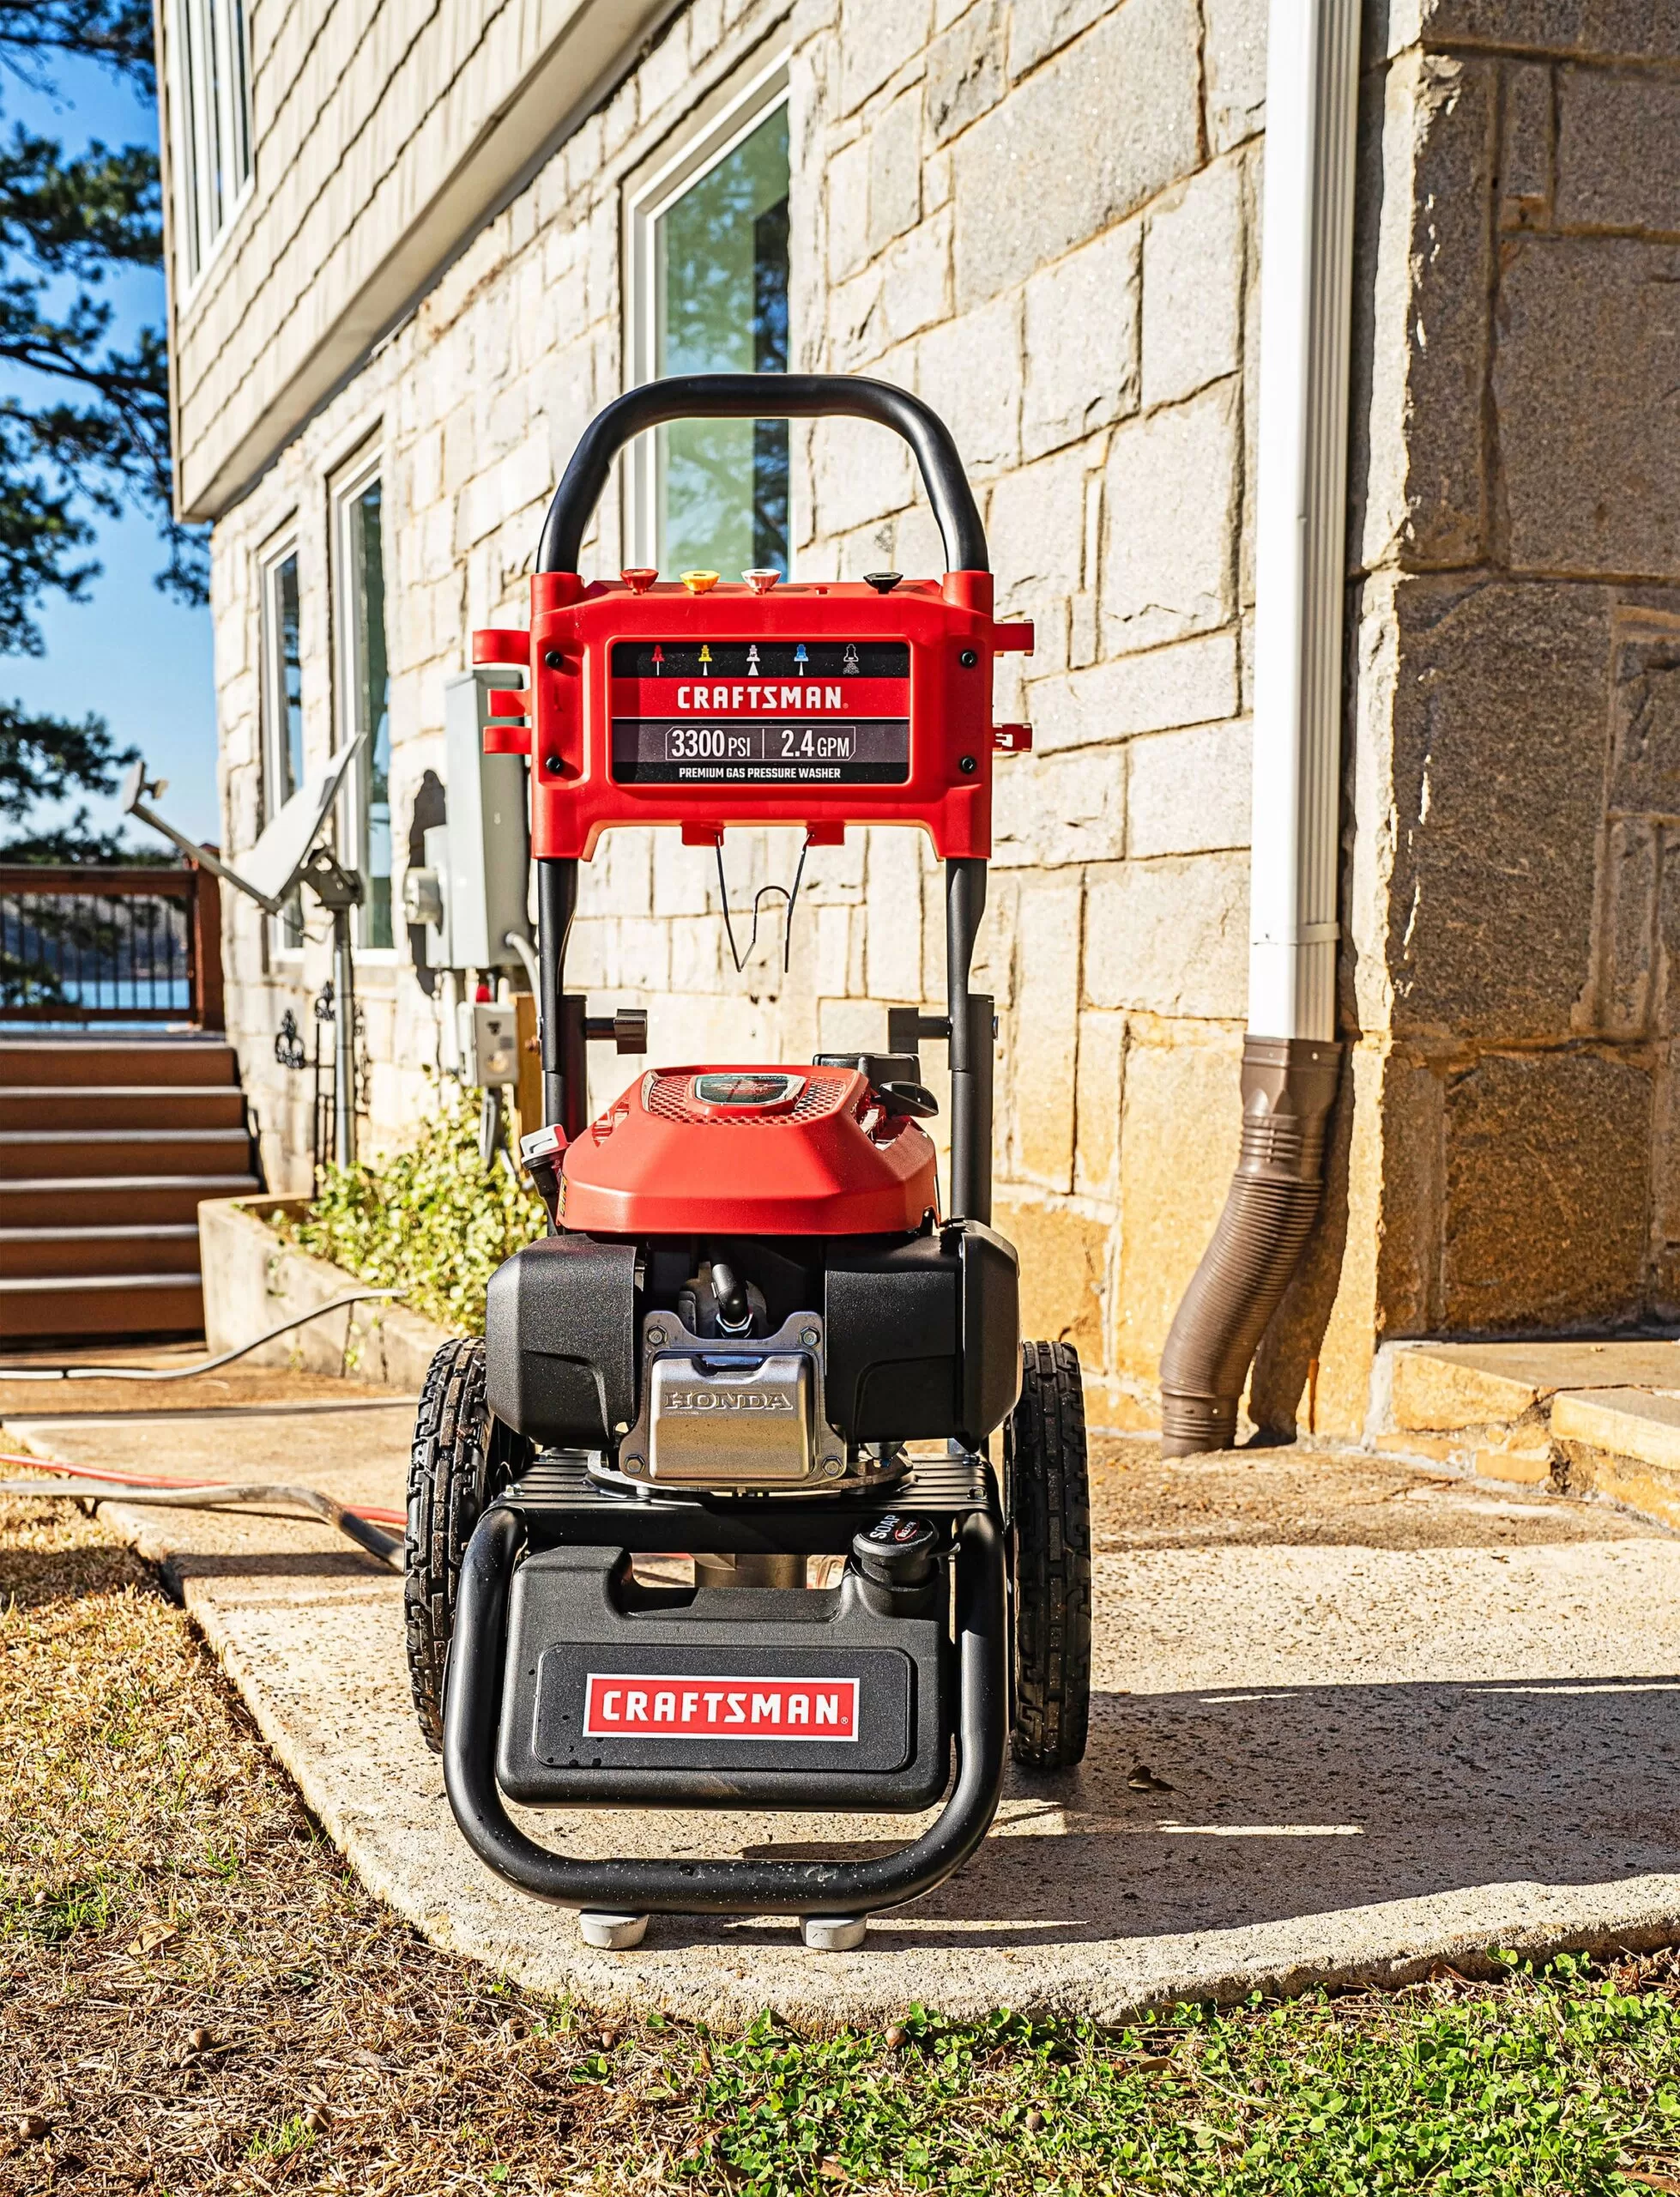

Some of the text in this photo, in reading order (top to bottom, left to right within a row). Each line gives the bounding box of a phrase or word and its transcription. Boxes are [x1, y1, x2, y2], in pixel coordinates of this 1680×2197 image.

[671, 729, 849, 757] 3300 PSI 2.4 GPM
[679, 767, 841, 778] PREMIUM GAS PRESSURE WASHER
[664, 1391, 794, 1411] HONDA
[869, 1514, 901, 1540] SOAP
